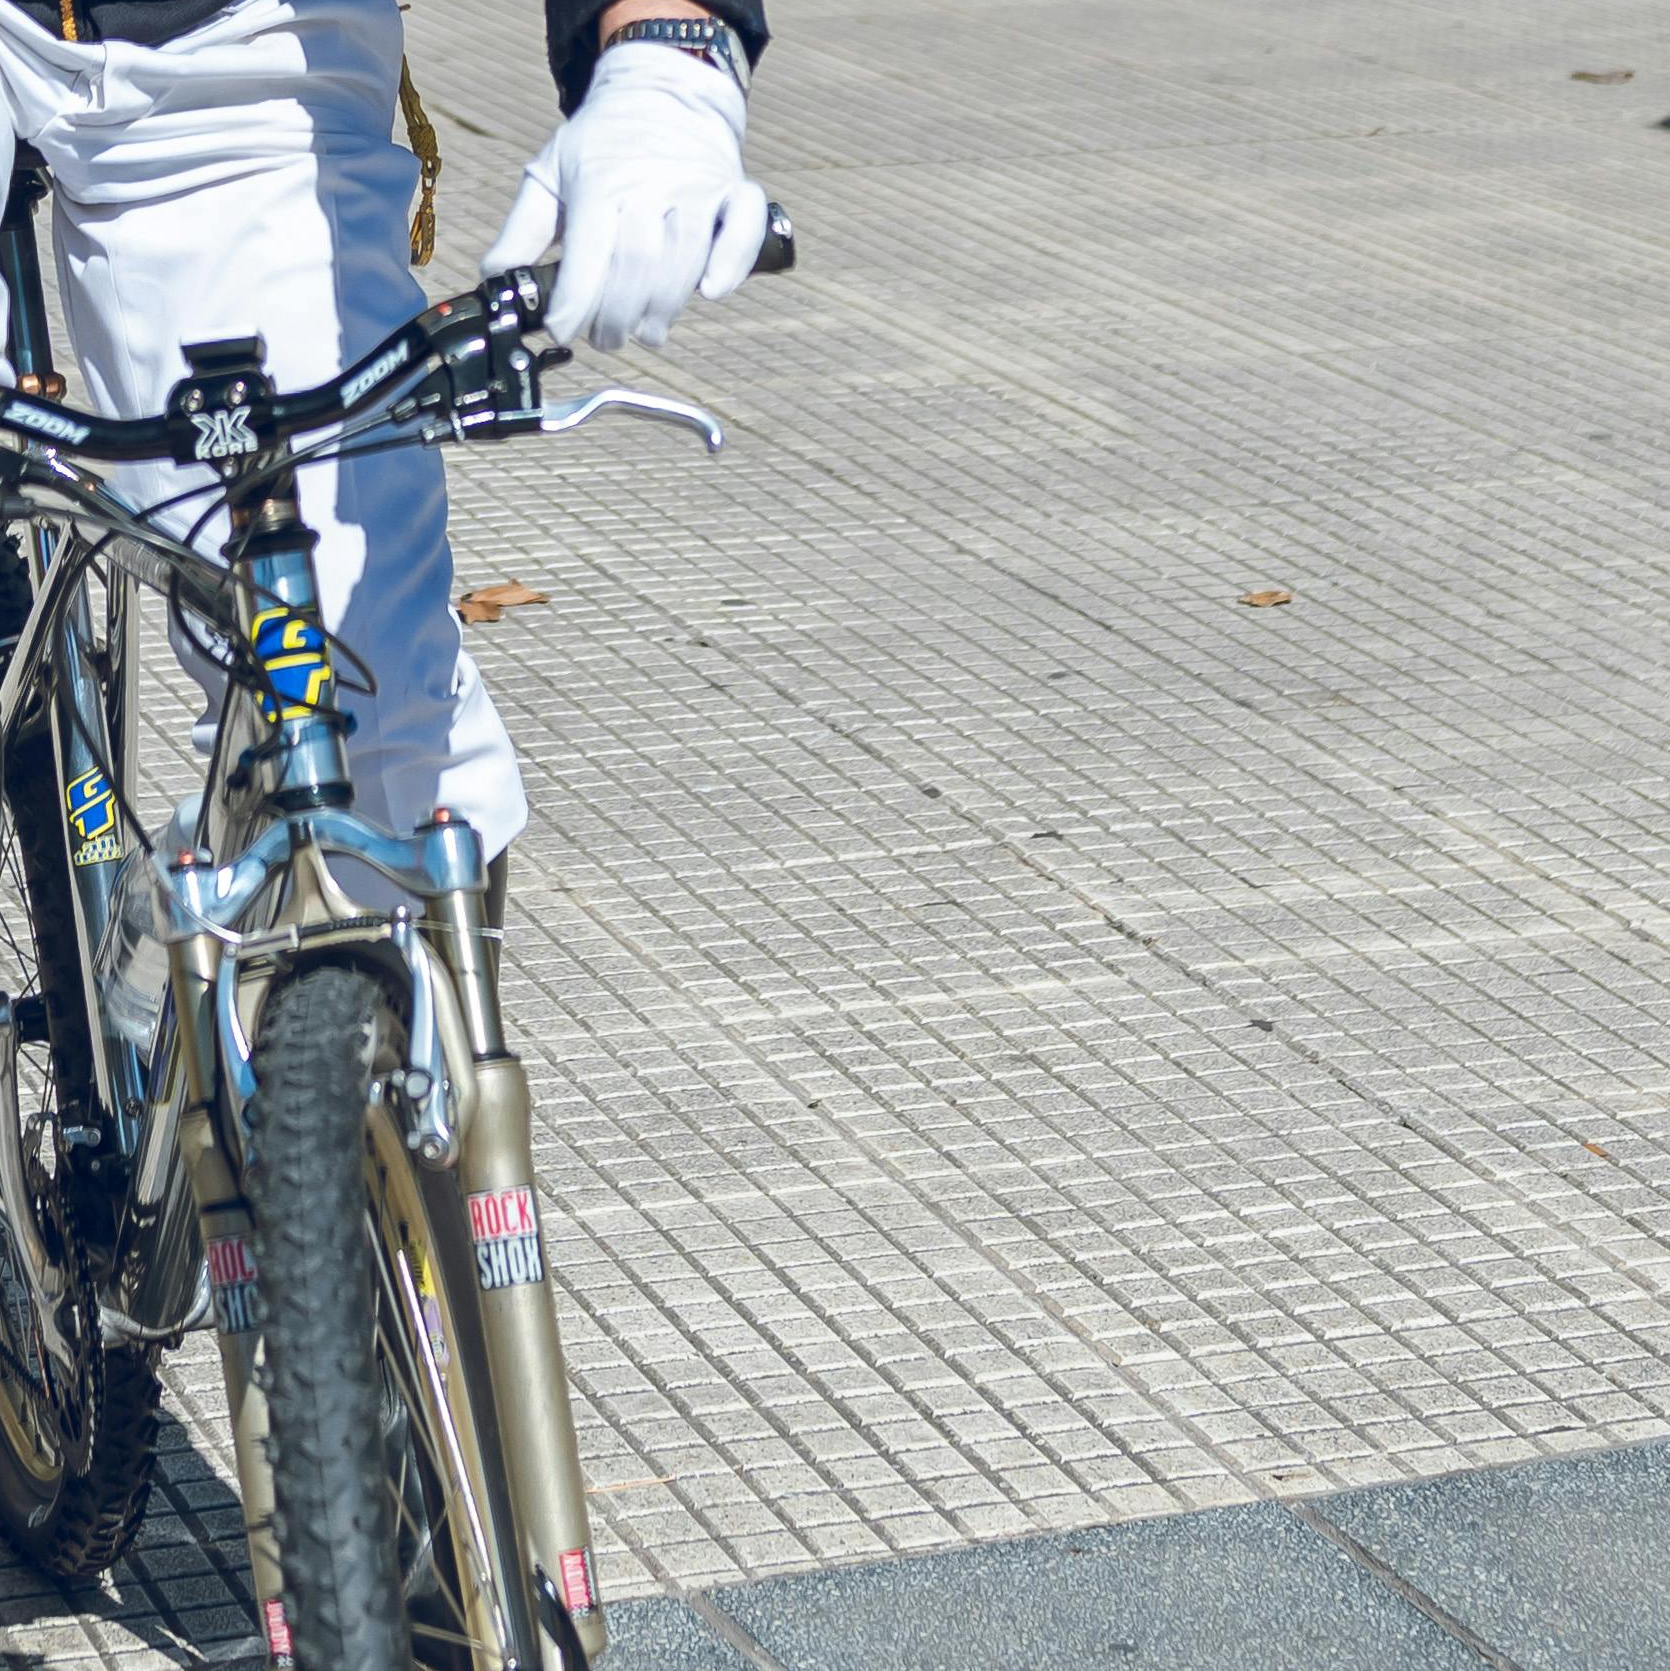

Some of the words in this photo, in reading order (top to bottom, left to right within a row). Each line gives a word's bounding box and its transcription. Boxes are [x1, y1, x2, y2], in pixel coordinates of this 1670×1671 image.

[340, 337, 408, 409] ZOOM
[2, 400, 91, 446] ZOOM
[66, 766, 116, 840] GT
[468, 1190, 534, 1242] ROCK
[207, 1239, 258, 1286] ROC
[476, 1236, 543, 1290] SHOX
